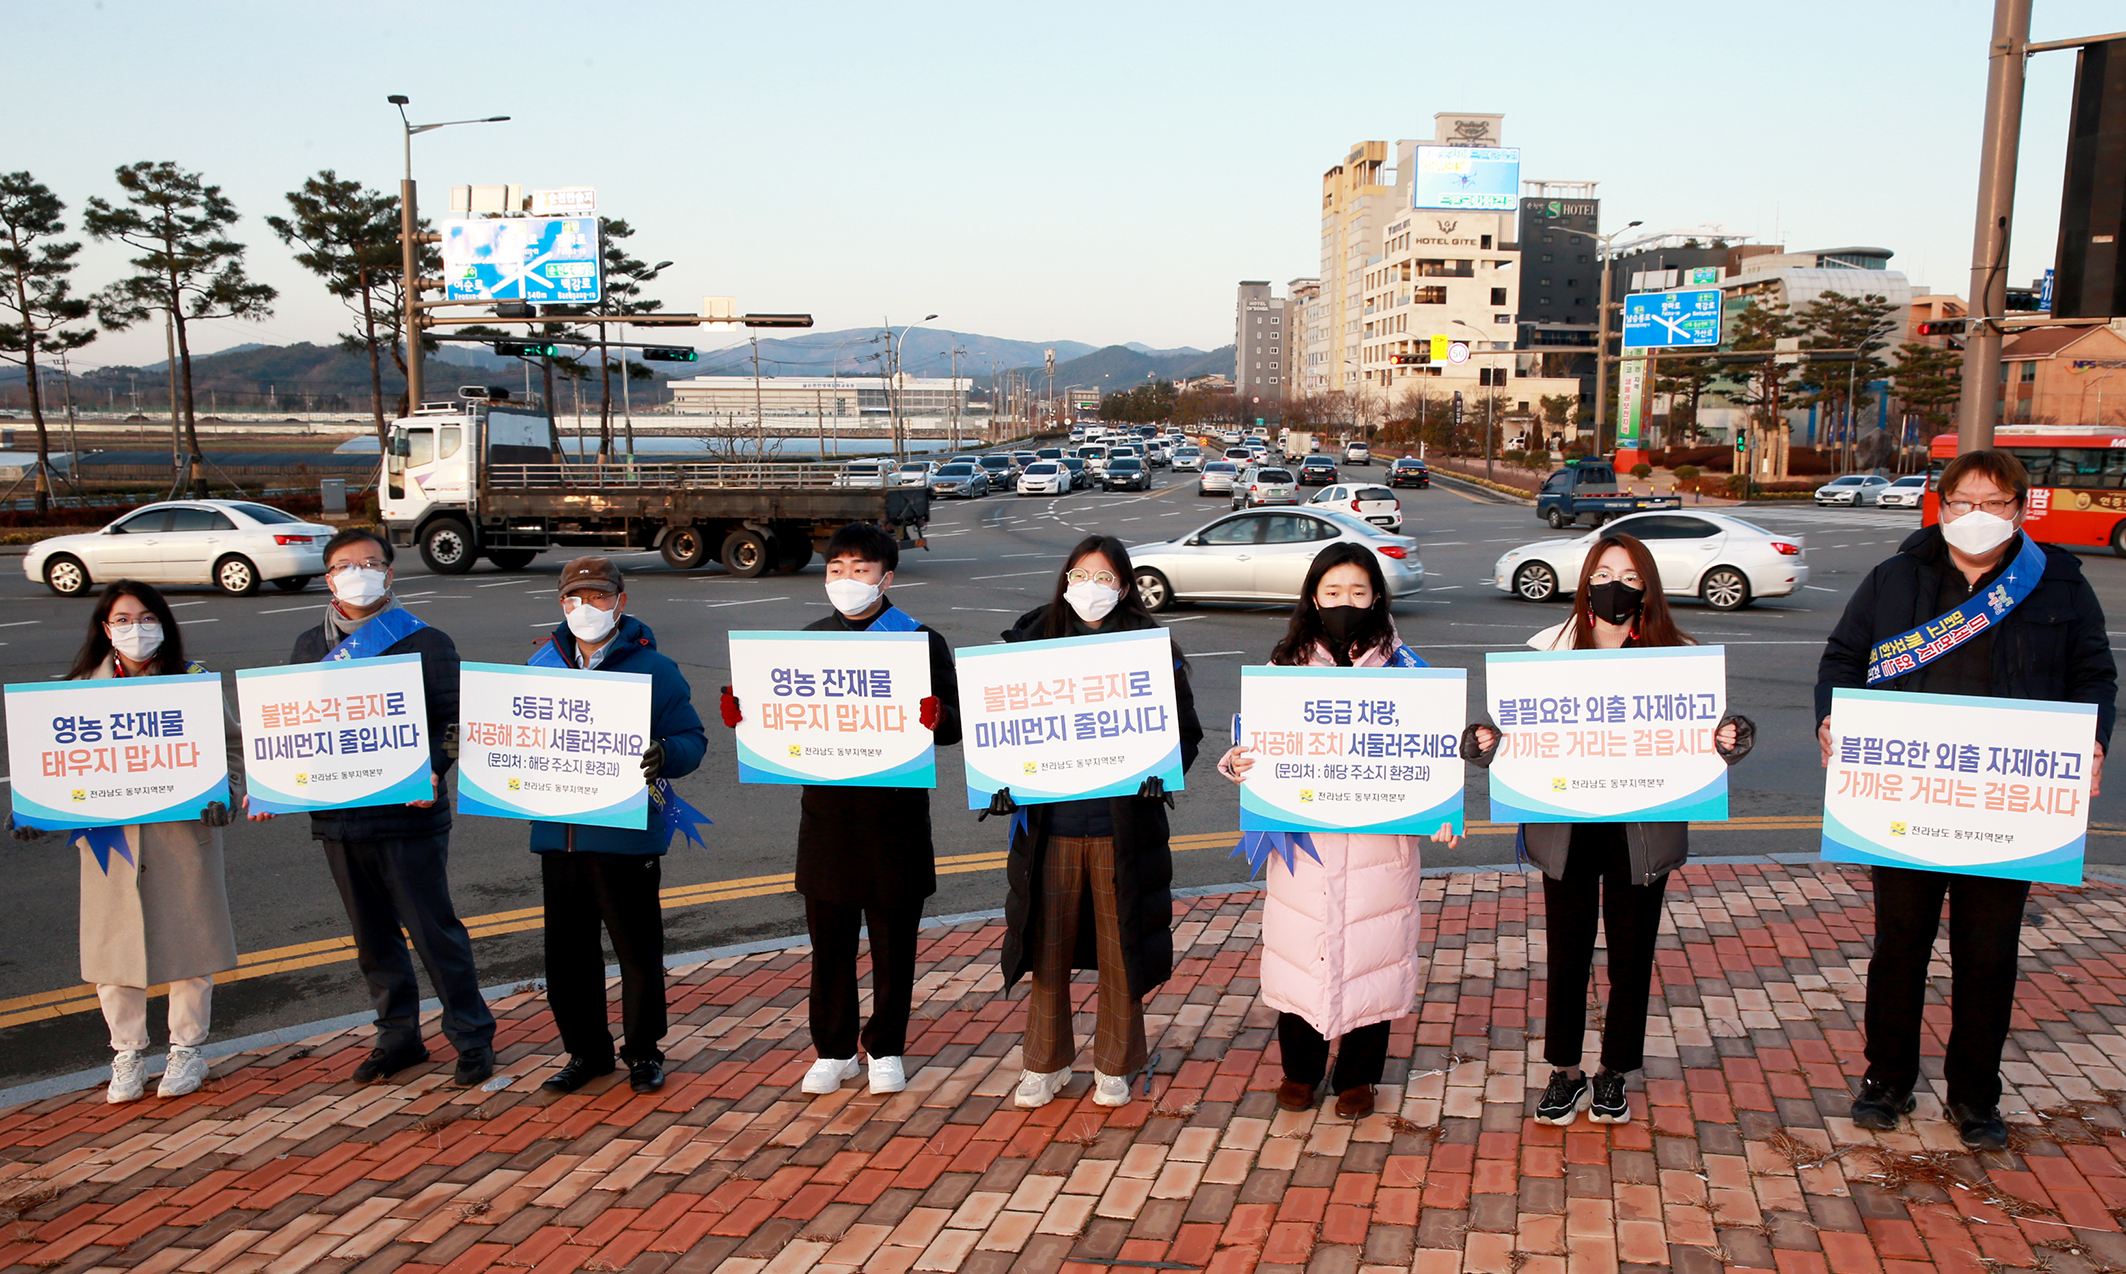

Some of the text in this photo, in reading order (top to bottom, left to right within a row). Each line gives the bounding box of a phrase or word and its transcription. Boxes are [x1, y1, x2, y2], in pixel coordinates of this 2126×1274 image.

[1563, 204, 1597, 216] HOTEL
[1452, 238, 1477, 246] GITE
[454, 279, 484, 291] 여순로
[527, 291, 548, 299] 340m
[561, 278, 592, 291] 백강로
[1694, 330, 1713, 338] 가산로
[1453, 349, 1465, 358] 50
[2073, 360, 2097, 369] NPS
[1621, 378, 1631, 434] 생물권보전지역
[1915, 612, 1990, 663] 미세먼지
[1926, 610, 1966, 638] 맑고
[1878, 631, 1926, 659] 깨끗한
[1881, 654, 1916, 677] 없는
[770, 668, 892, 698] 영농 잔재물
[983, 670, 1153, 713] 불법소각 금지로
[261, 691, 407, 729] 불법소각 금지로
[512, 696, 594, 725] 5등급 차량,
[762, 703, 908, 733] 태우지 맙시다
[1303, 699, 1400, 727] 5등급 차량,
[1498, 693, 1717, 726] 불필요한 외출 자제하고
[52, 709, 184, 744] 영농 잔재물
[975, 705, 1169, 748] 미세먼지 줄입시다
[254, 723, 420, 761] 미세먼지 줄입시다
[466, 722, 644, 759] 저공해 조치 서둘러주세요
[805, 747, 882, 757] 전라남도 동부지역본부
[1248, 731, 1458, 758] 저공해 조치 서둘러주세요
[1498, 728, 1560, 759] 가까운
[1566, 730, 1628, 758] 거리는
[41, 741, 201, 777] 태우지 맙시다
[528, 755, 550, 772] 해당
[551, 757, 583, 774] 주소지
[585, 760, 620, 778] 환경과)
[1041, 755, 1125, 772] 전라남도 동부지역본부
[1840, 735, 2082, 780] 불필요한 외출 자제하고
[311, 768, 383, 783] 전라남도 동부지역본부
[1323, 763, 1349, 780] 해당
[1350, 764, 1387, 780] 주소지
[1389, 765, 1430, 782] 환경과)
[1571, 778, 1665, 789] 전라남도 동부지역본부
[90, 784, 174, 799] 전라남도 동부지역본부
[523, 781, 599, 796] 전라남도 동부지역본부
[1318, 792, 1406, 803] 전라남도 동부지역본부
[1837, 770, 2080, 817] 가까운 거리는 걸읍시다
[1911, 825, 2014, 844] 전라남도 동부지역본부
